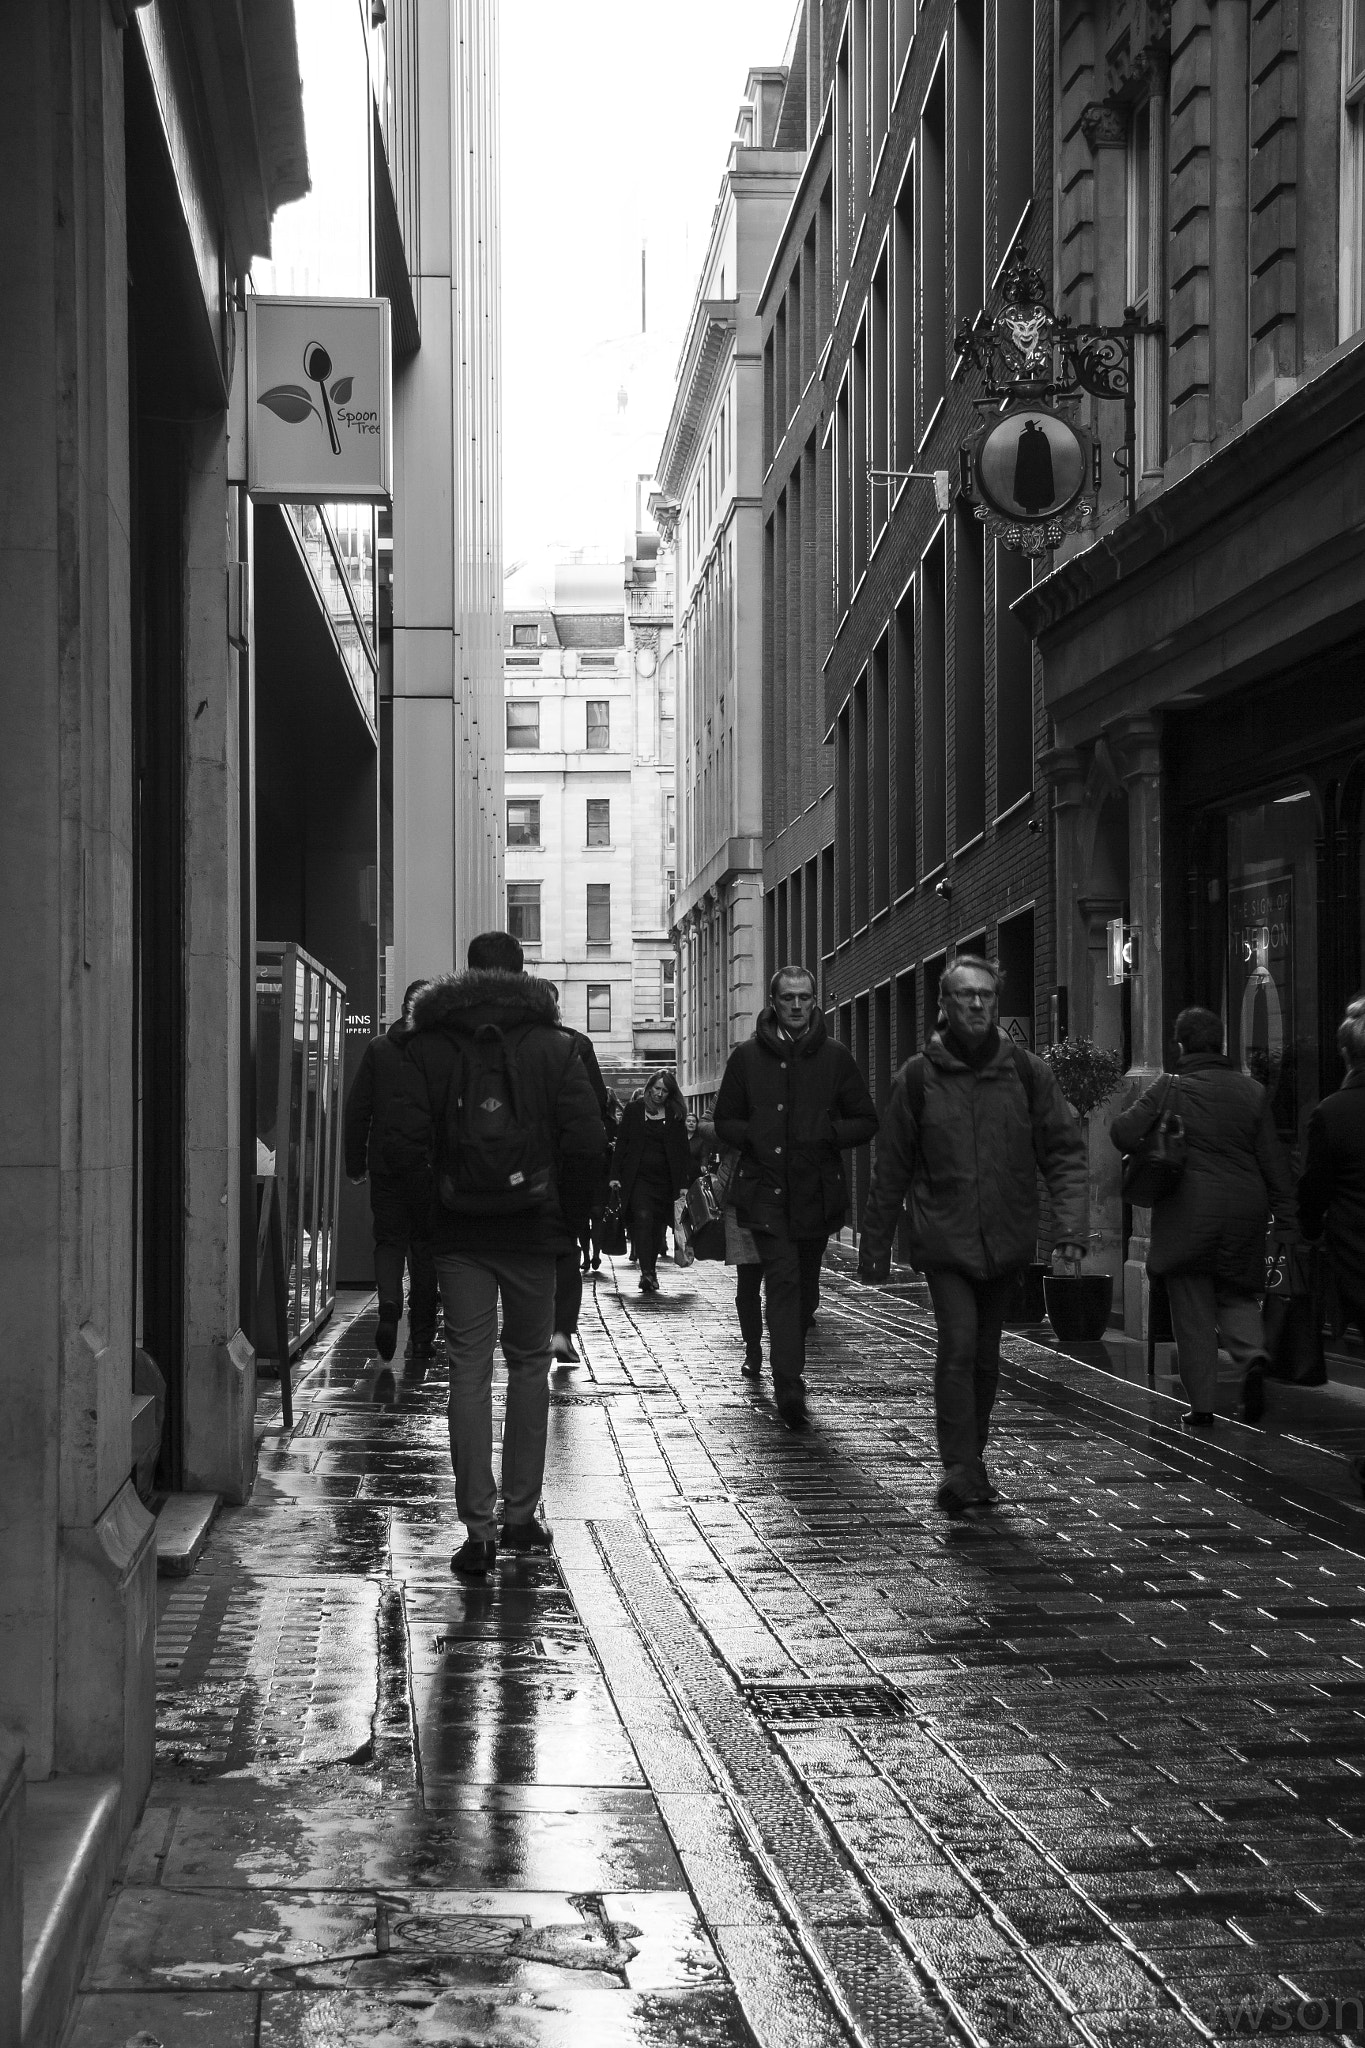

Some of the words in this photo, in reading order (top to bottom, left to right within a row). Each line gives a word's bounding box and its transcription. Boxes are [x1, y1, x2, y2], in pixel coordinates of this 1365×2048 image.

[337, 408, 377, 428] Spoon
[351, 421, 380, 434] Tree
[1233, 902, 1248, 920] TE
[1251, 897, 1273, 916] SIGN
[1277, 893, 1289, 911] OF
[1233, 927, 1258, 955] THE
[1262, 922, 1289, 950] DON
